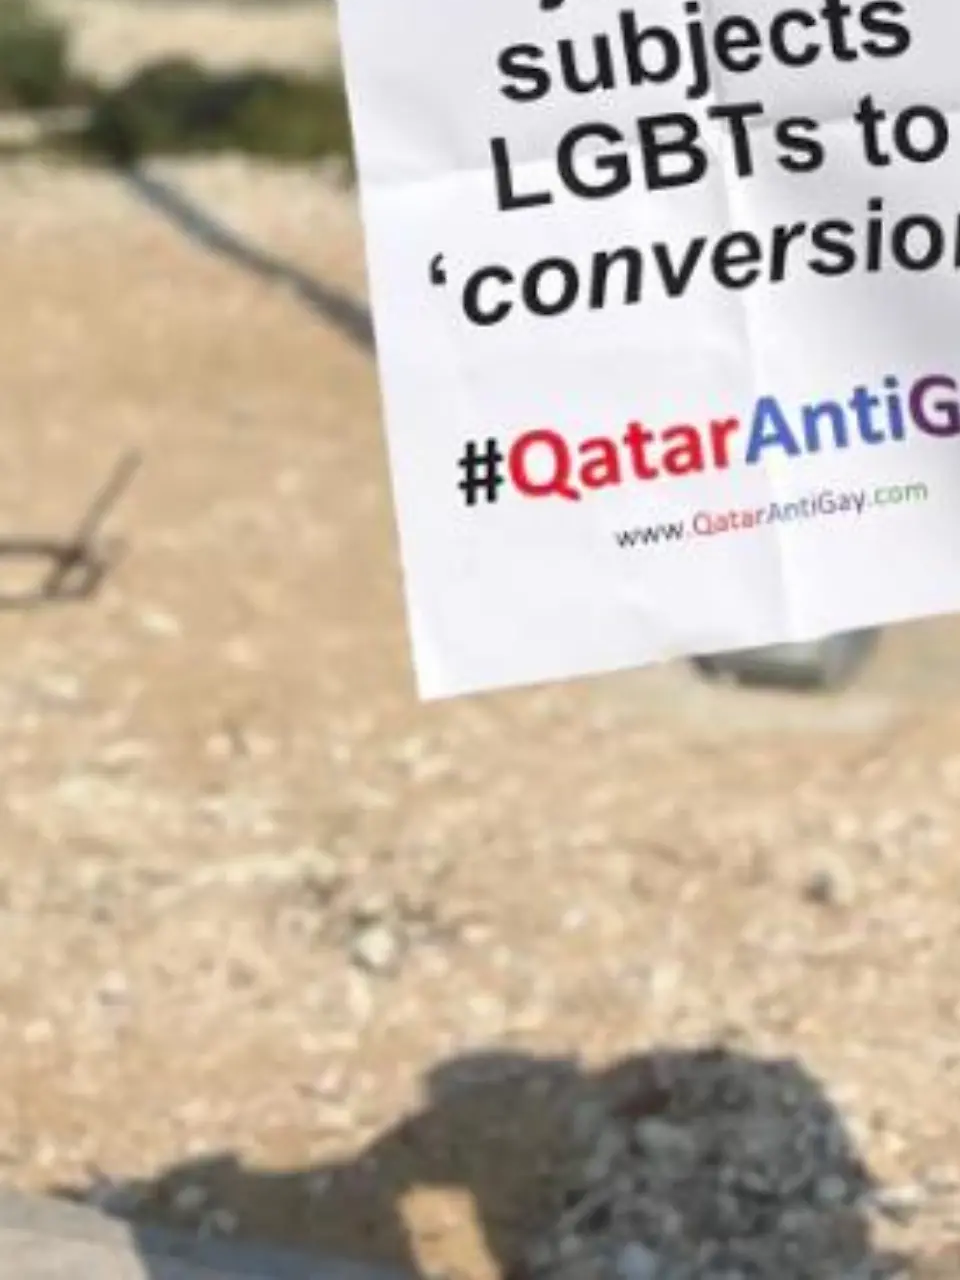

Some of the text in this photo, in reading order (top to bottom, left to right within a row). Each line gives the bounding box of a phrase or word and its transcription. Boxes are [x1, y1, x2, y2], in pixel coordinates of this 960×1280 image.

[490, 94, 950, 212] LGBTs to
[615, 481, 929, 549] www.QatarAntiGay.com
